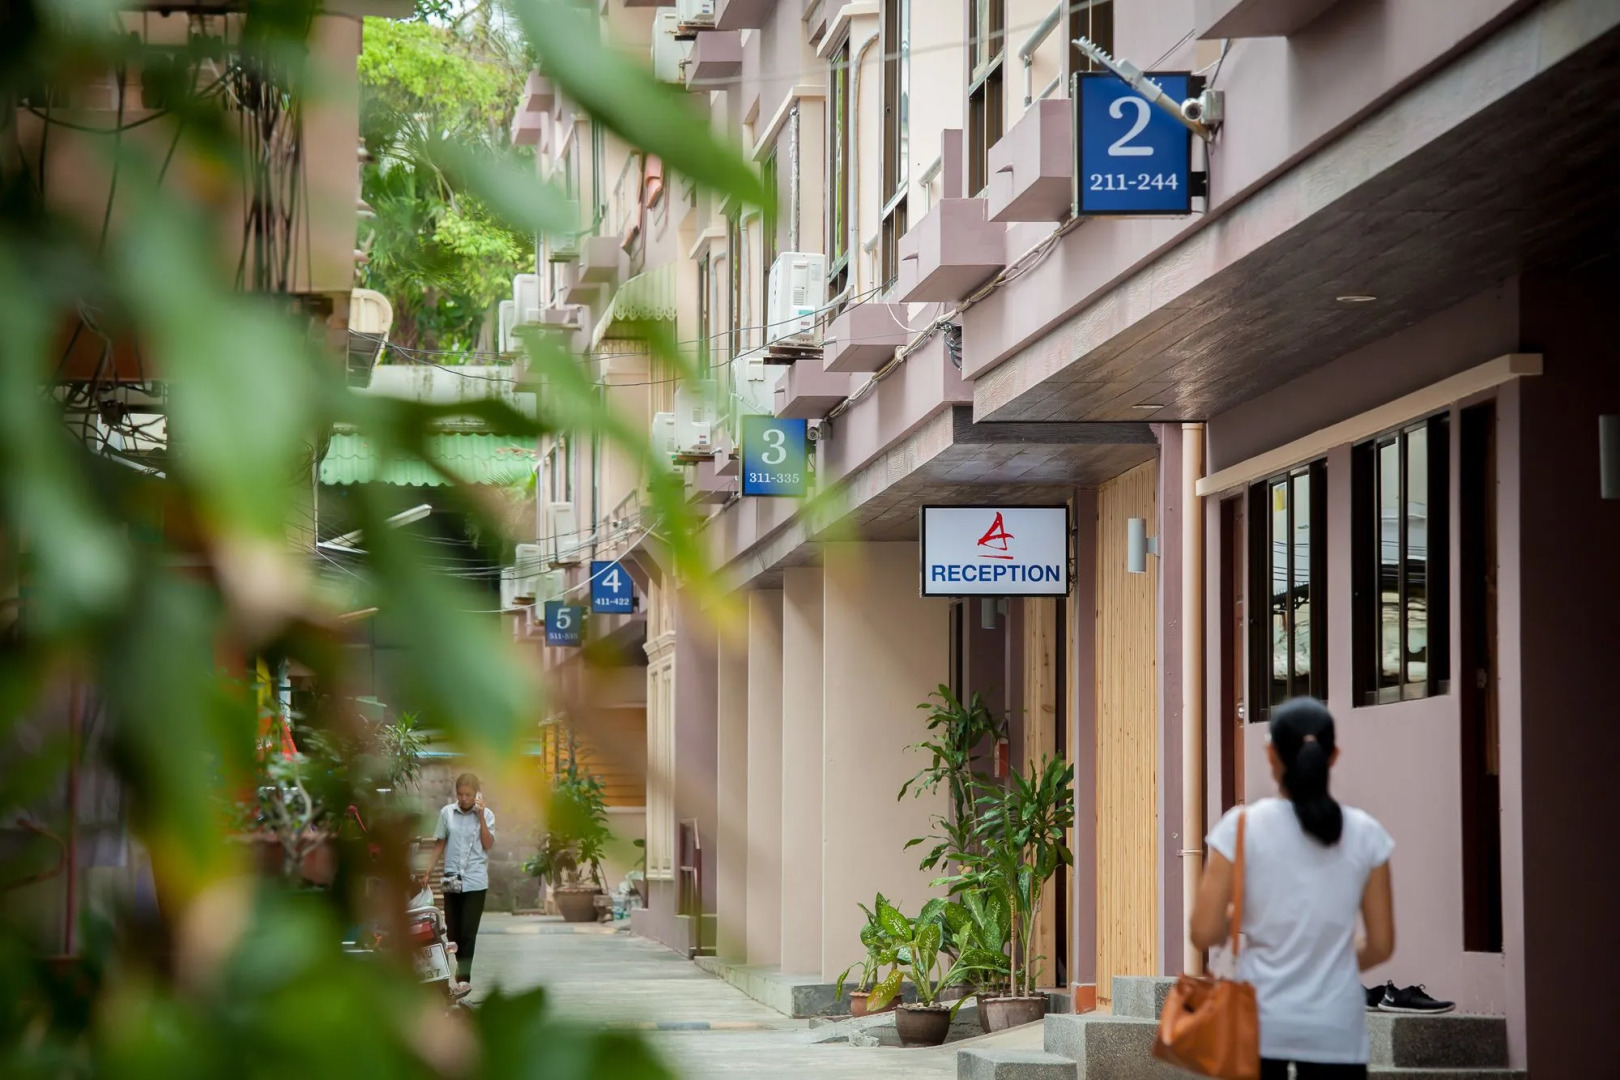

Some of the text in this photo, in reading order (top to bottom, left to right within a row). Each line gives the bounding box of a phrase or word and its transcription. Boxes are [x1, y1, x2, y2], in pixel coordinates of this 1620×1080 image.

[1107, 96, 1154, 156] 2
[1090, 173, 1179, 191] 211-244
[761, 429, 787, 465] 3
[749, 472, 800, 484] 311-335
[601, 568, 622, 593] 4
[931, 564, 1060, 582] RECEPTION
[594, 597, 630, 606] 411-422
[556, 607, 571, 629] 5
